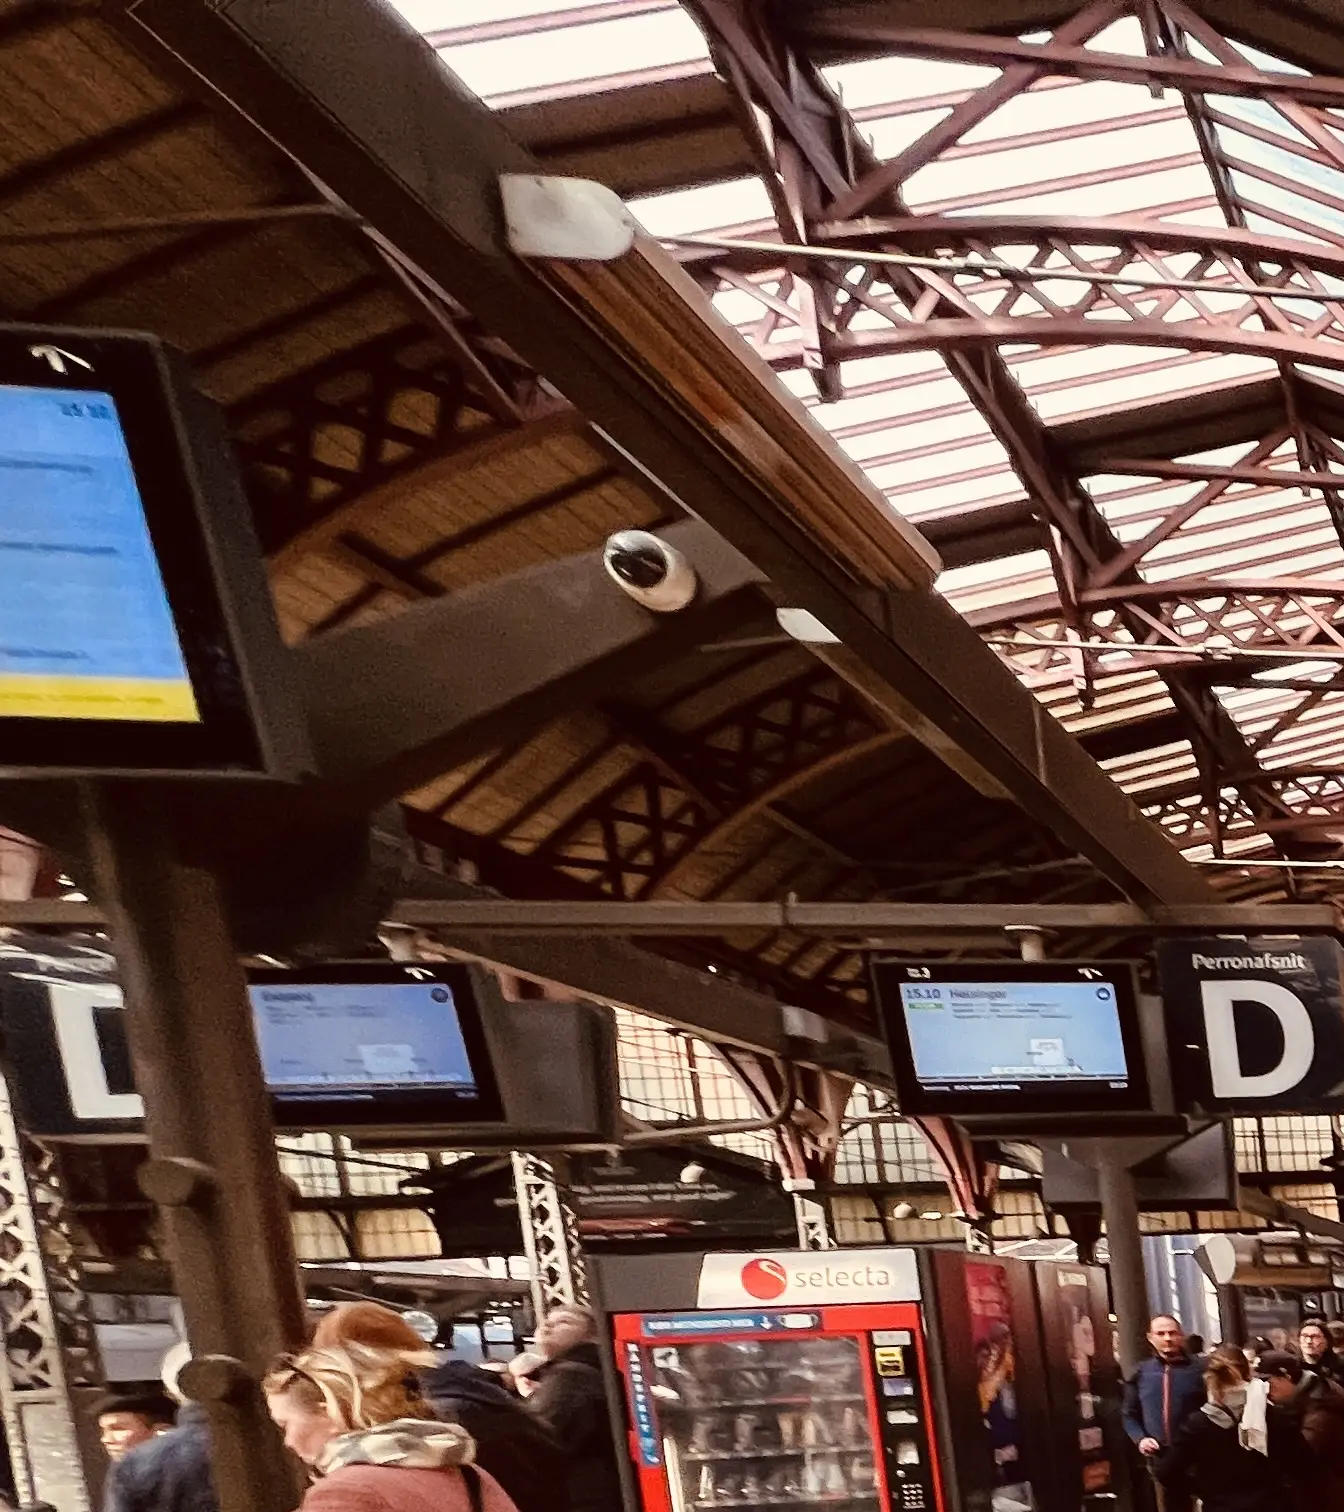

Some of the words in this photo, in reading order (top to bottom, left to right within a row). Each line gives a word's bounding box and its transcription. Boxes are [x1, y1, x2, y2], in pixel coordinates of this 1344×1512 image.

[1191, 953, 1307, 970] Perronafsnit
[1200, 979, 1315, 1098] D
[795, 1266, 890, 1288] selecta
